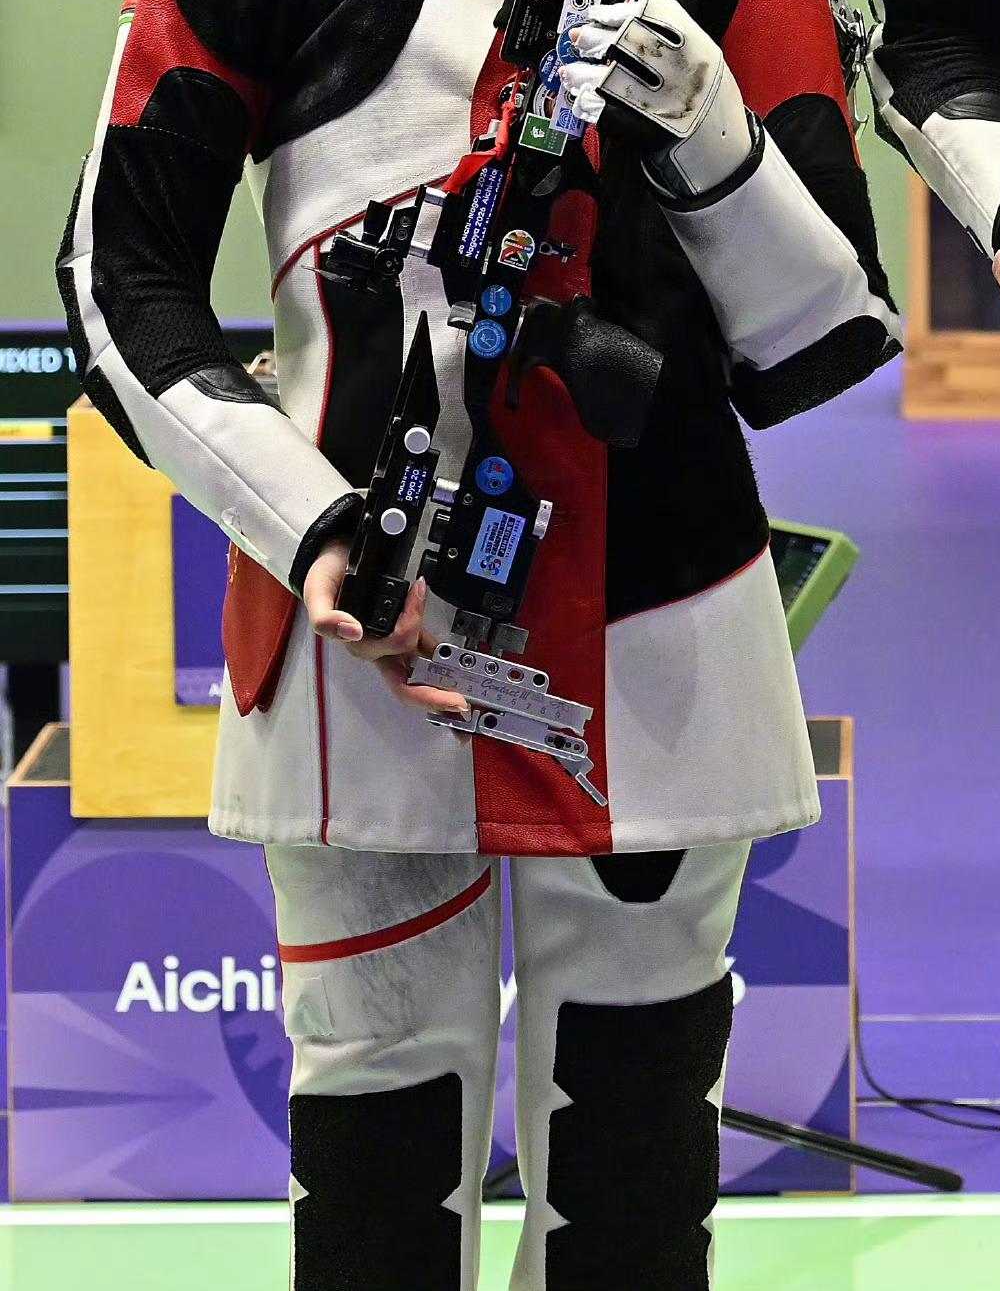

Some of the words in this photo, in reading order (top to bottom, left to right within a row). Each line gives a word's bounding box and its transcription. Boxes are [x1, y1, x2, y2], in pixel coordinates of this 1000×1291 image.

[461, 188, 482, 242] Aichi-Nagoya
[477, 168, 488, 187] 2026
[465, 228, 480, 257] Nagoya
[474, 207, 486, 226] 2026
[482, 169, 497, 204] Aichi-Na
